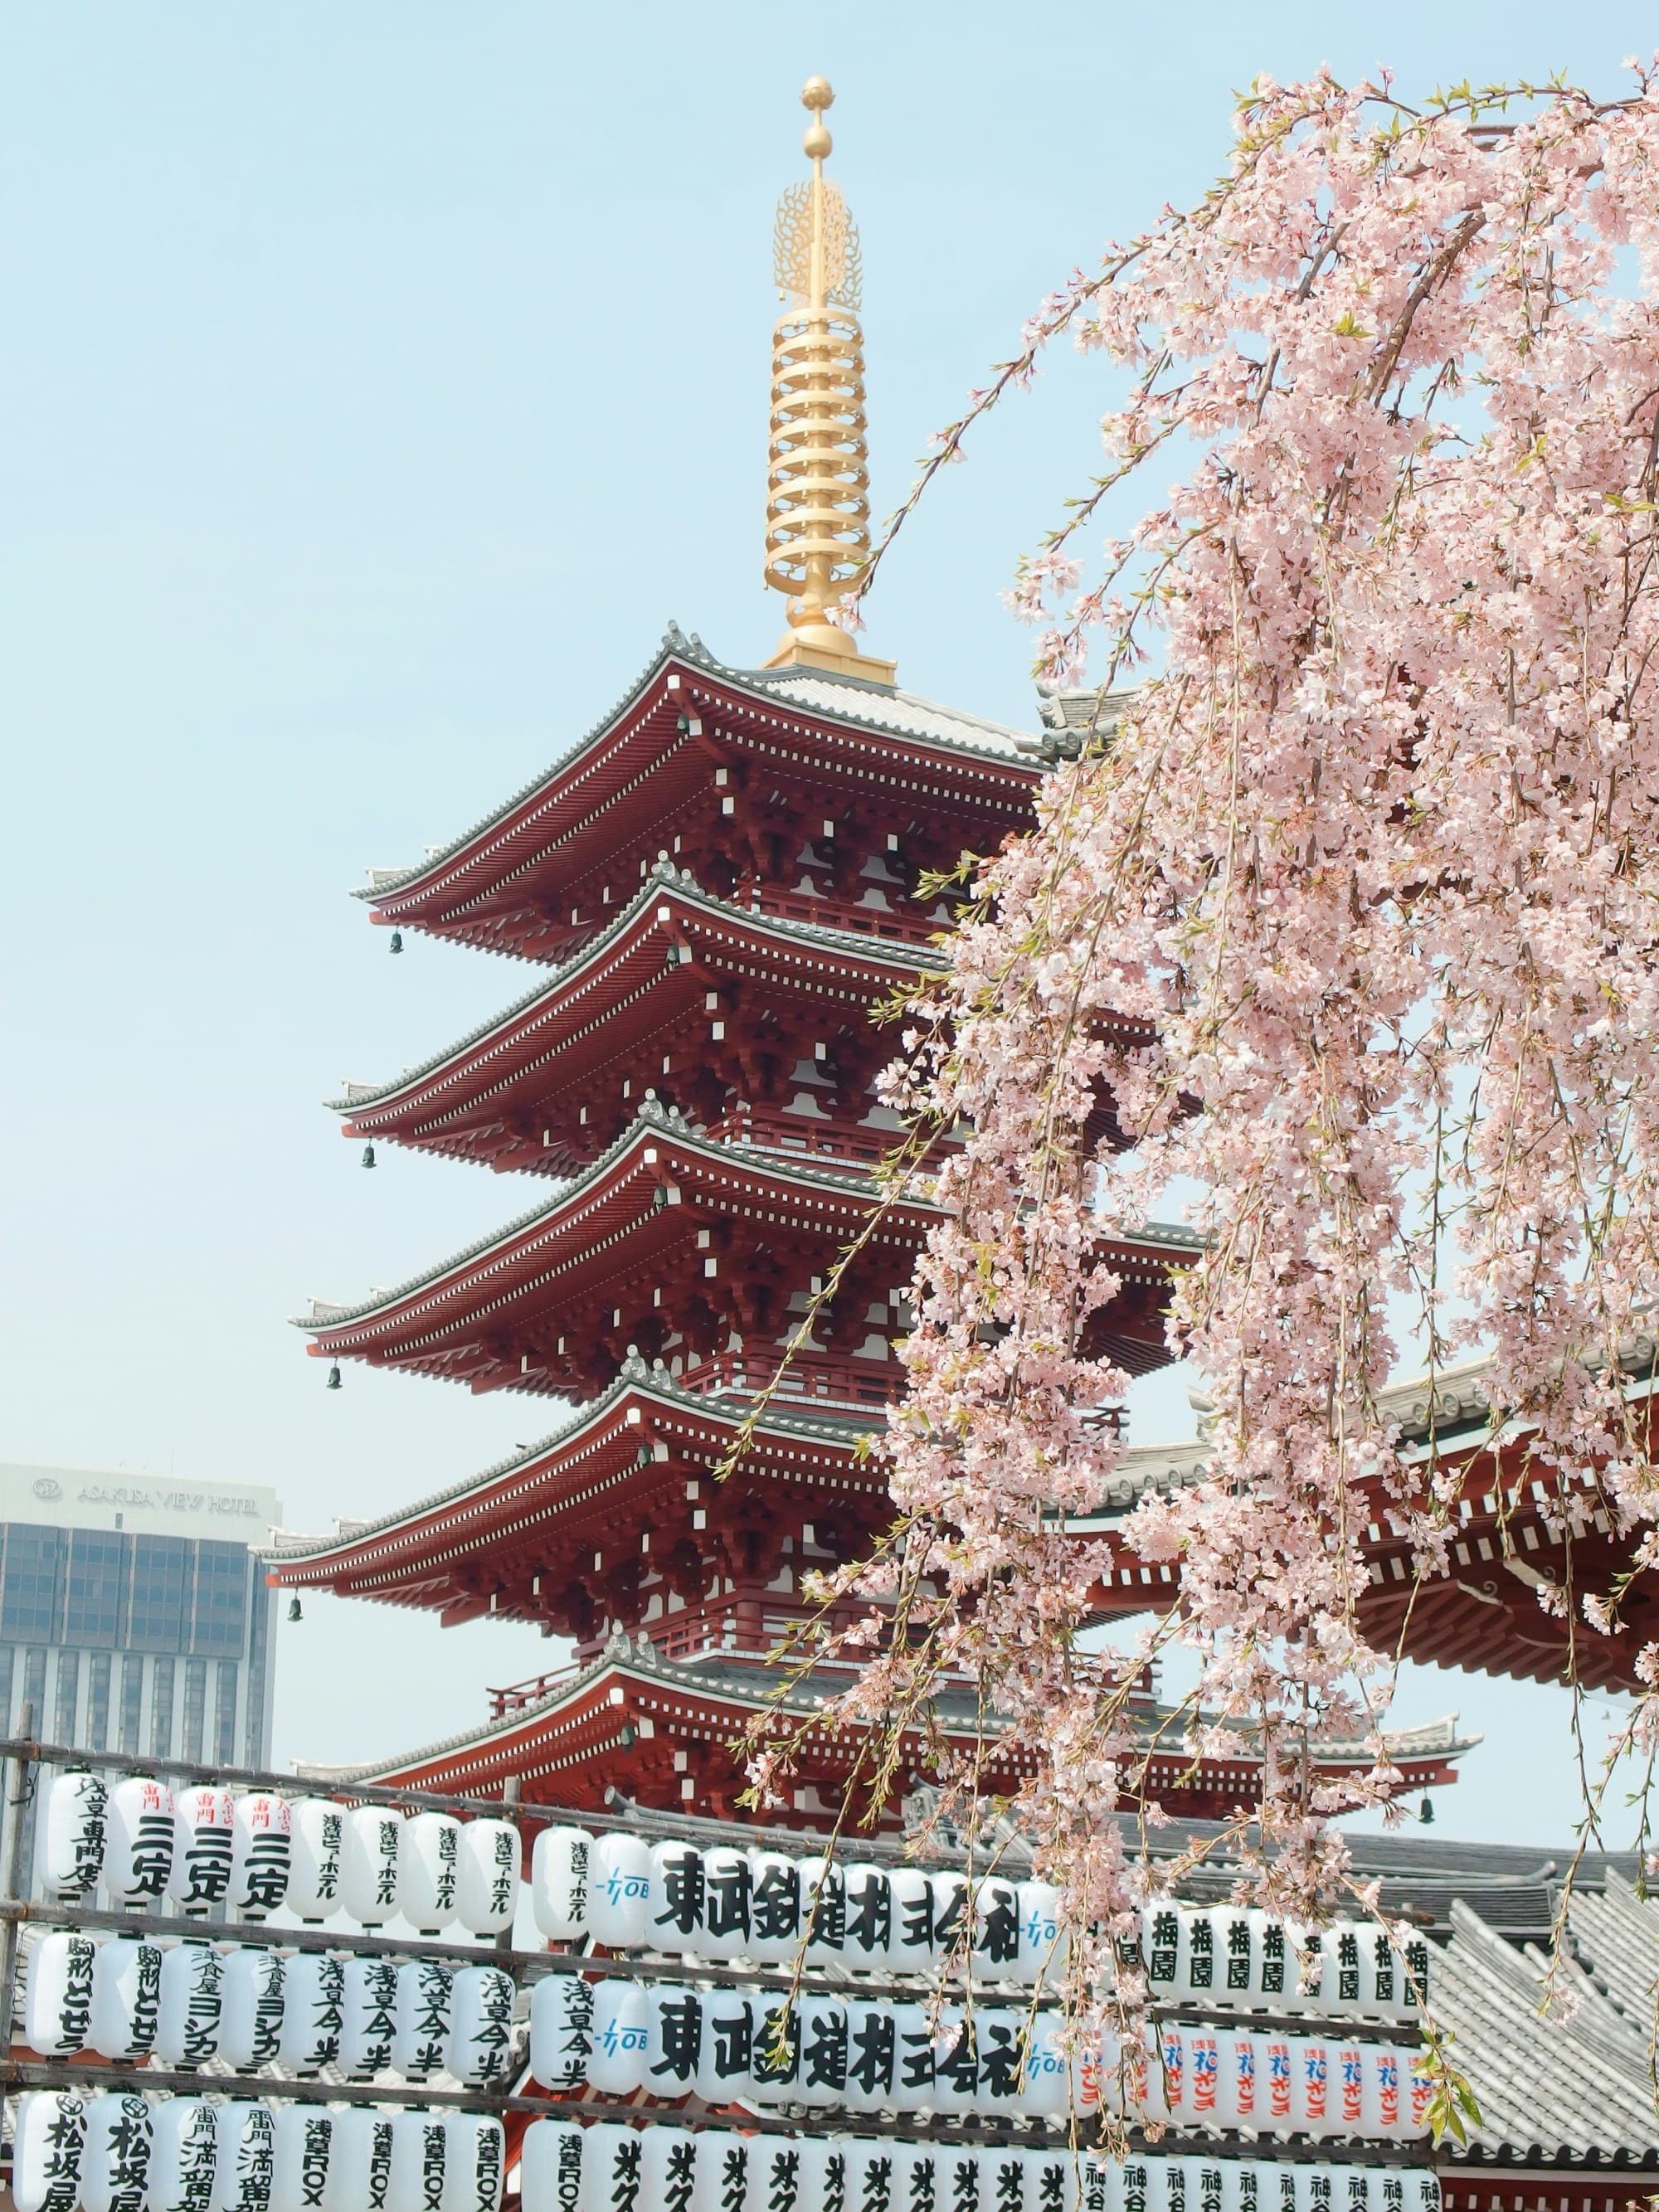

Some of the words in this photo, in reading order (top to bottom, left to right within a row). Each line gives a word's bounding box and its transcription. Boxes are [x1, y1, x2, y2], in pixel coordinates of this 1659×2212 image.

[79, 1486, 152, 1506] ASAKUSA
[158, 1491, 202, 1510] VIEW
[207, 1495, 259, 1515] HOTEL
[140, 1783, 160, 1811] 雷門
[196, 1792, 216, 1825] 雷門
[252, 1798, 271, 1828] 雷門
[124, 1816, 175, 1896] 三定
[180, 1827, 233, 1903] 三定
[236, 1834, 291, 1908] 三定
[1151, 1911, 1178, 1982] 梅園
[1190, 1918, 1213, 1988] 梅園
[1228, 1921, 1250, 1990] 梅園
[1261, 1924, 1284, 1993] 梅園
[1338, 1933, 1359, 2001] 梅園
[1374, 1935, 1393, 2001] 梅園
[55, 1937, 95, 2054] 駒形どぜう
[124, 1946, 162, 2058] 駒形どぜう
[180, 1950, 225, 2065] 洋食屋ヨシカミ
[245, 1955, 287, 2068] 洋食屋ヨシカミ
[304, 1957, 345, 2069] 浅草今半
[355, 1963, 399, 2073] 浅草今半
[407, 1966, 455, 2073] 浅草今半
[469, 1972, 513, 2080] 浅草今半
[551, 1979, 596, 2087] 浅草今半
[35, 2113, 88, 2212] 松坂屋
[300, 2118, 333, 2206] 浅草ROX
[367, 2122, 393, 2210] 浅草ROX
[423, 2125, 445, 2211] 浅草ROX
[475, 2127, 501, 2212] 浅草ROX
[1039, 2164, 1064, 2212] 米
[1123, 2165, 1147, 2212] 神谷
[1167, 2167, 1185, 2212] 神谷
[1200, 2169, 1223, 2212] 神谷
